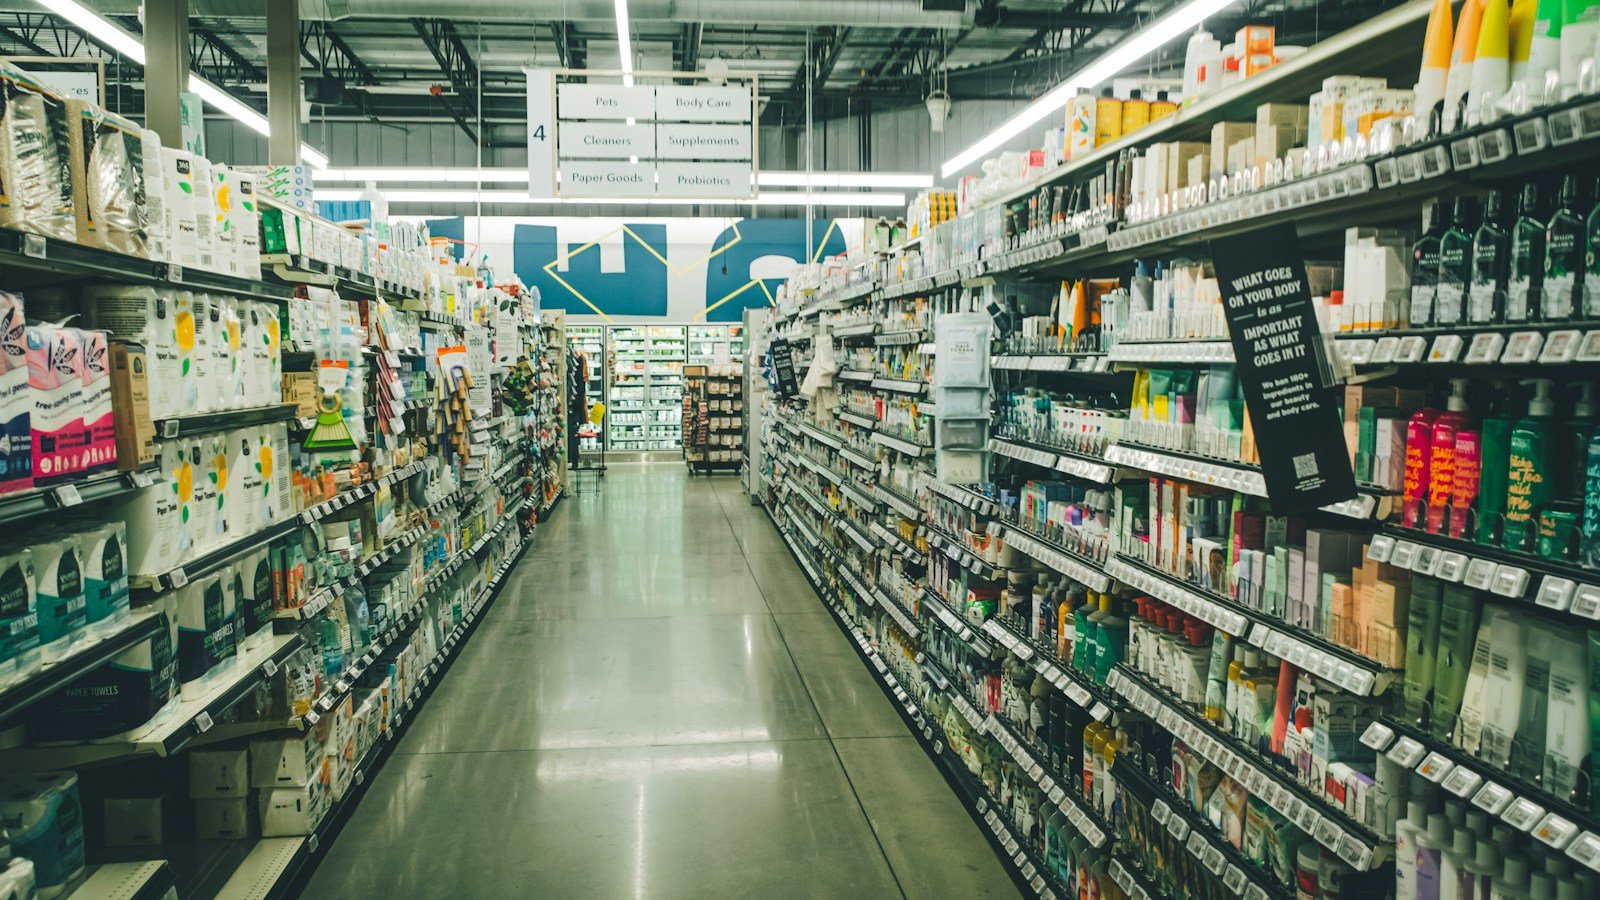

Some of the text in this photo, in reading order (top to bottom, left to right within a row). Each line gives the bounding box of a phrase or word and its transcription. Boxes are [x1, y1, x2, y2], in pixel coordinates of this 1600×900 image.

[596, 97, 618, 107] Pets
[676, 98, 731, 110] Body Care
[532, 124, 546, 141] 4
[584, 136, 631, 146] Cleaners
[669, 136, 740, 147] Supplements
[572, 173, 643, 183] Paper Goods
[677, 175, 731, 185] Probiotics
[1232, 266, 1292, 292] WHAT GOES
[1229, 280, 1301, 308] ON YOUR BODY
[1257, 305, 1282, 318] is as
[1243, 316, 1302, 341] IMPORTANT
[1254, 331, 1299, 352] AS WHAT
[1254, 344, 1305, 367] GOES IN IT
[1262, 372, 1308, 389] We ban 180+
[1263, 384, 1304, 400] ingredients
[1270, 394, 1310, 408] our beauty
[1267, 402, 1320, 420] and body care.
[66, 685, 119, 697] PAPER TOWELS
